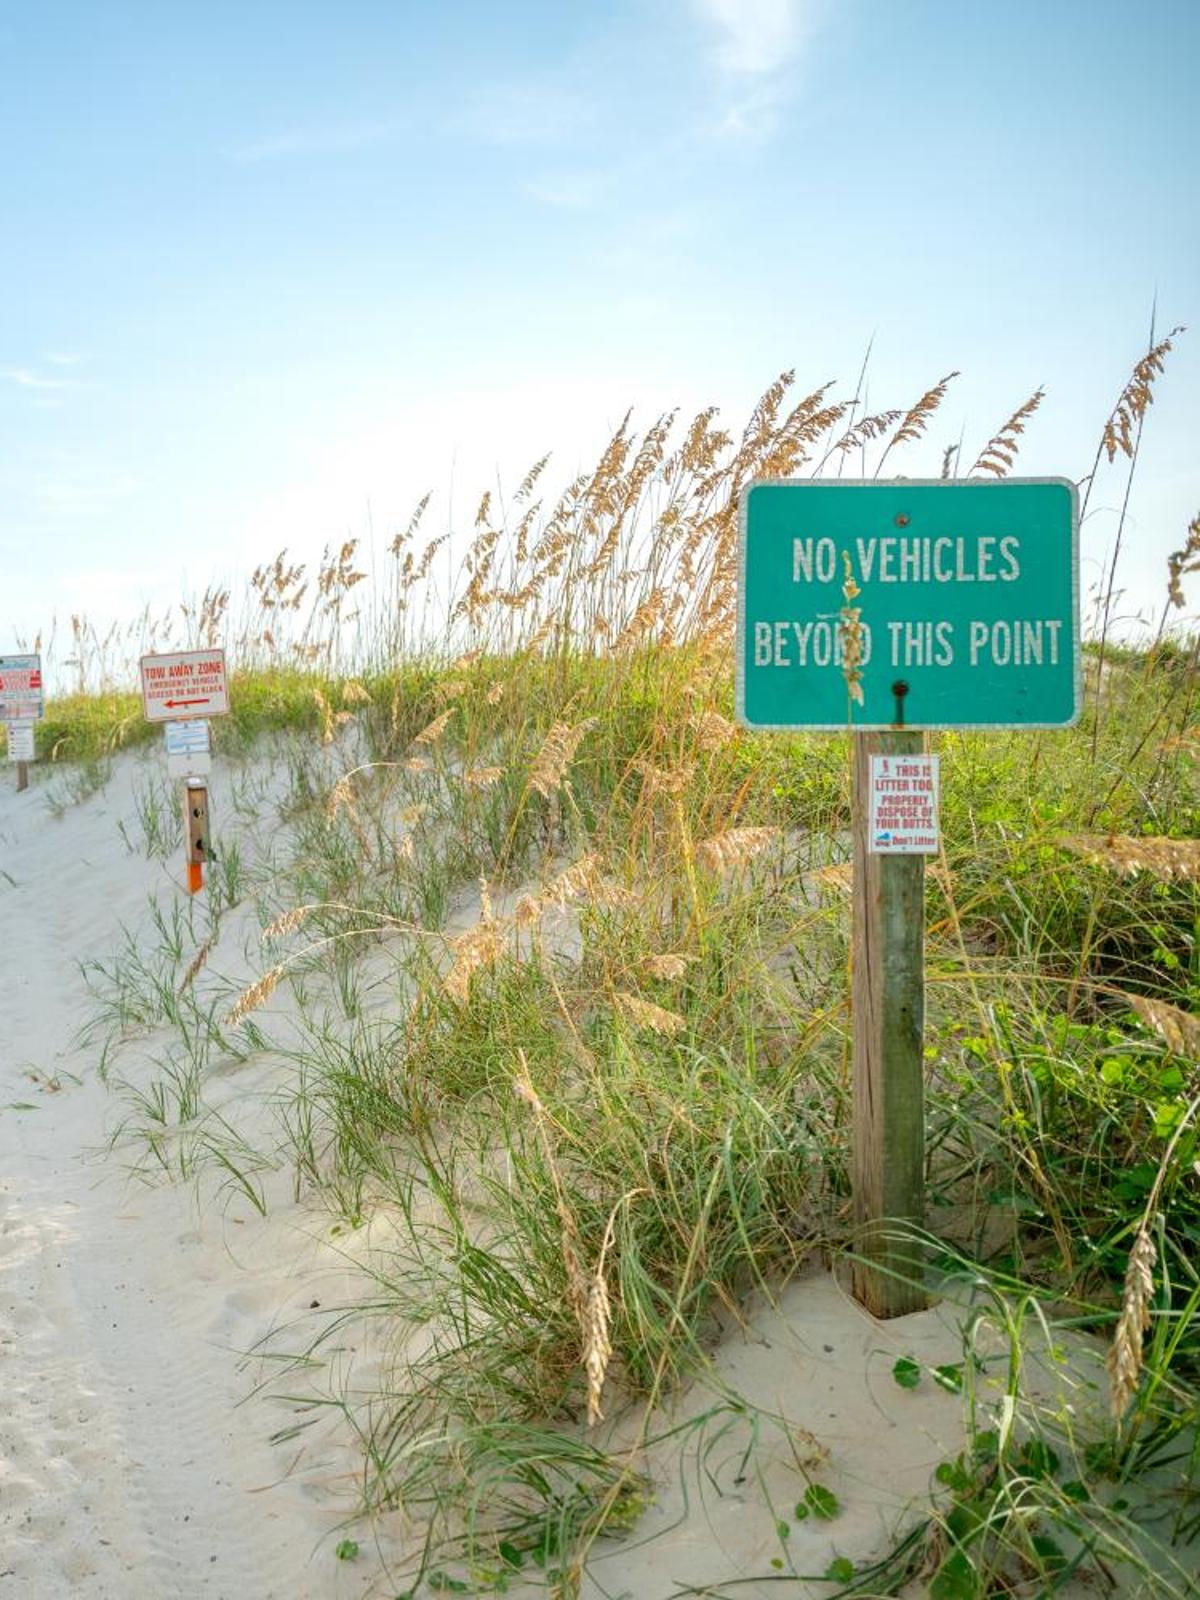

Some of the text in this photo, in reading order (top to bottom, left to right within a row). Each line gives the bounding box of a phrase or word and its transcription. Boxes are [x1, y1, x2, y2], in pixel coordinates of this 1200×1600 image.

[792, 536, 1021, 583] NO VEHICLES
[887, 621, 954, 667] THIS
[969, 620, 1063, 667] POINT
[144, 661, 222, 679] TOW AWAY ZONE
[895, 765, 932, 776] THIS IS
[875, 779, 933, 791] LITTER TOO
[882, 795, 928, 805] PROPERLY
[877, 807, 932, 817] DISPOSE OF
[875, 819, 900, 829] YOUR
